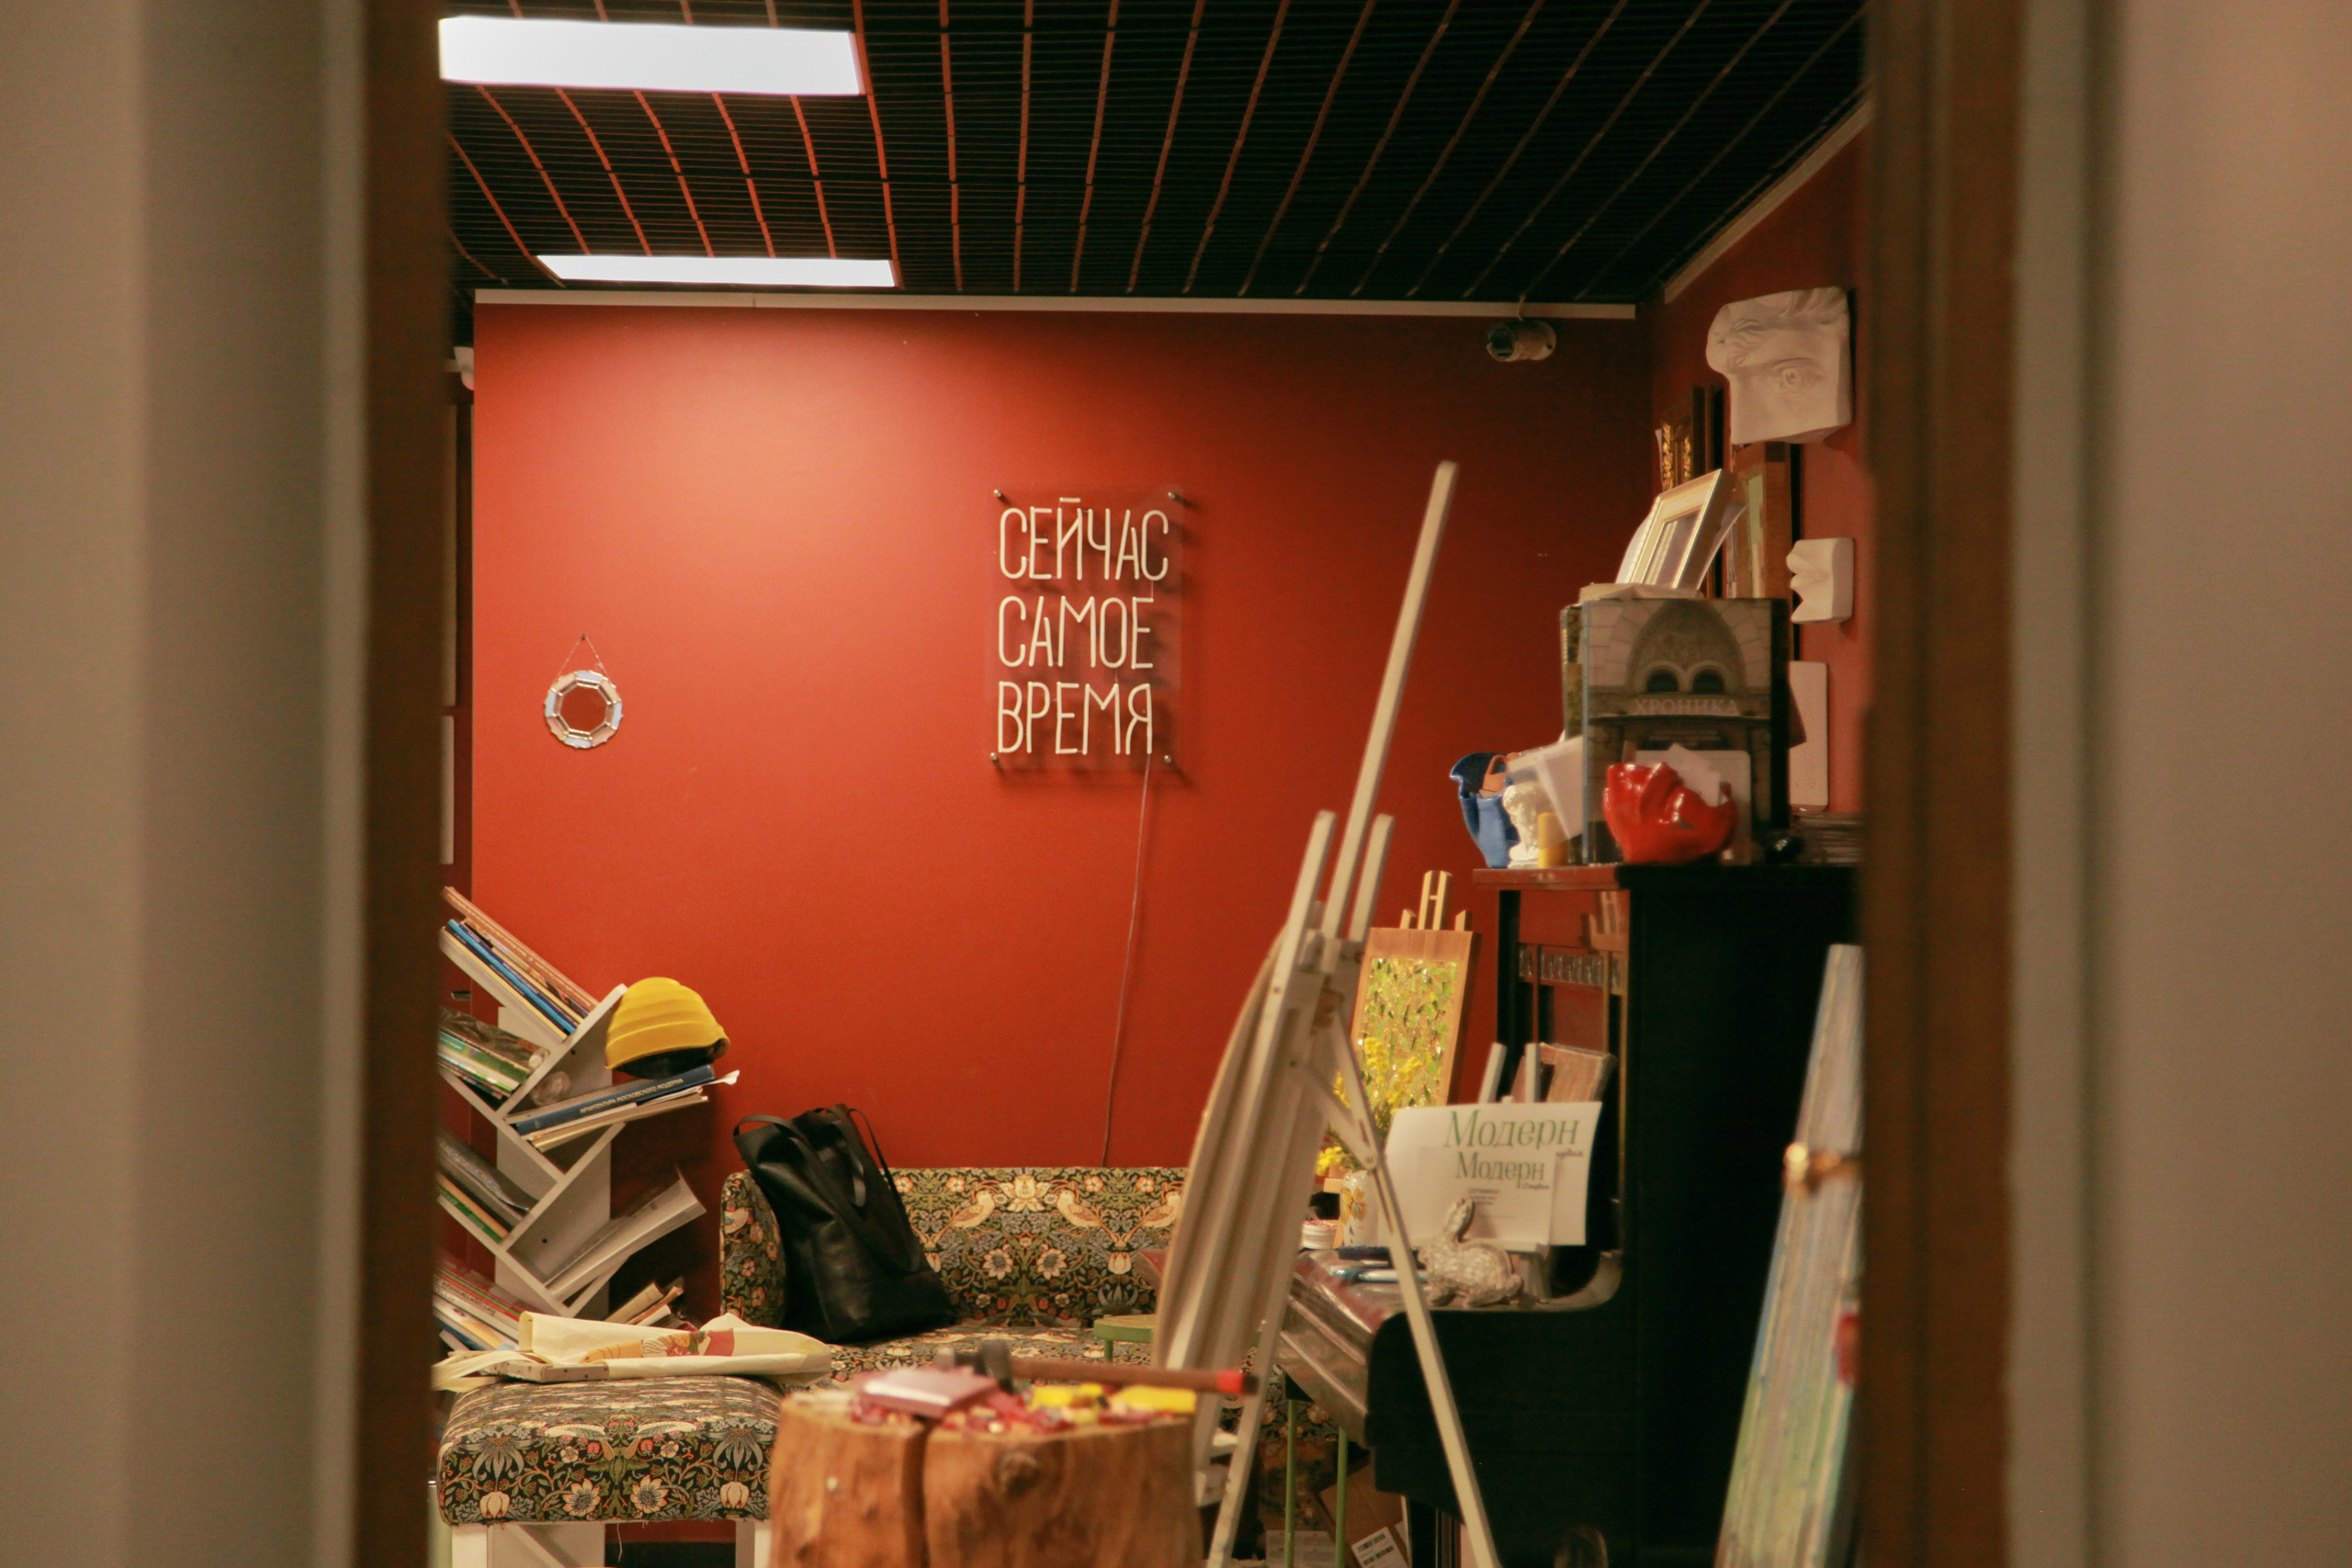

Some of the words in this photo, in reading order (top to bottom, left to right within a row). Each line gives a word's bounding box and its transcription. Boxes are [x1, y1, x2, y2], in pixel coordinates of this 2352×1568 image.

[1000, 497, 1169, 581] СЕЙЧАС
[998, 596, 1154, 670] САМОЕ
[998, 681, 1152, 755] ВРЕМЯ
[1634, 698, 1740, 716] ХРОНИКА
[1442, 1109, 1580, 1149] Модерн
[1455, 1151, 1544, 1189] Модерн
